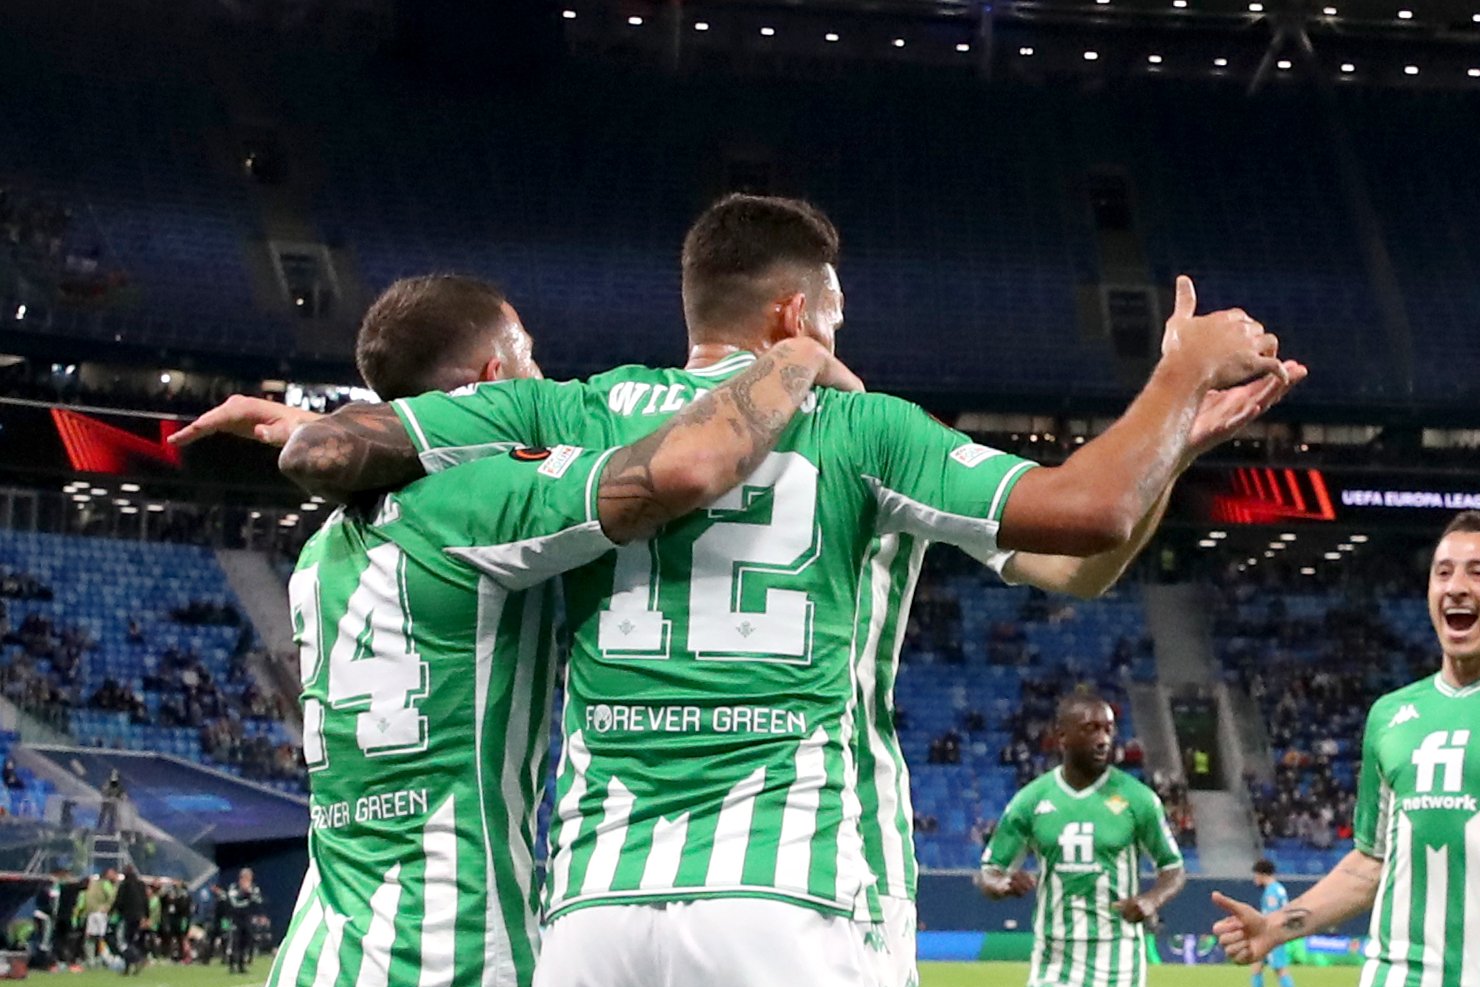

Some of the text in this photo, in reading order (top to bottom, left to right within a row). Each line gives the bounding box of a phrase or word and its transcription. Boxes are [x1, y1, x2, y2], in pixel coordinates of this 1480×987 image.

[1341, 490, 1383, 506] UEFA
[1384, 491, 1444, 508] EUROPA
[598, 451, 822, 665] 12
[586, 704, 807, 733] FOREVER GREEN
[1411, 729, 1470, 792] fi
[355, 789, 427, 822] GREEN
[1402, 793, 1477, 812] network
[1058, 821, 1095, 862] fi
